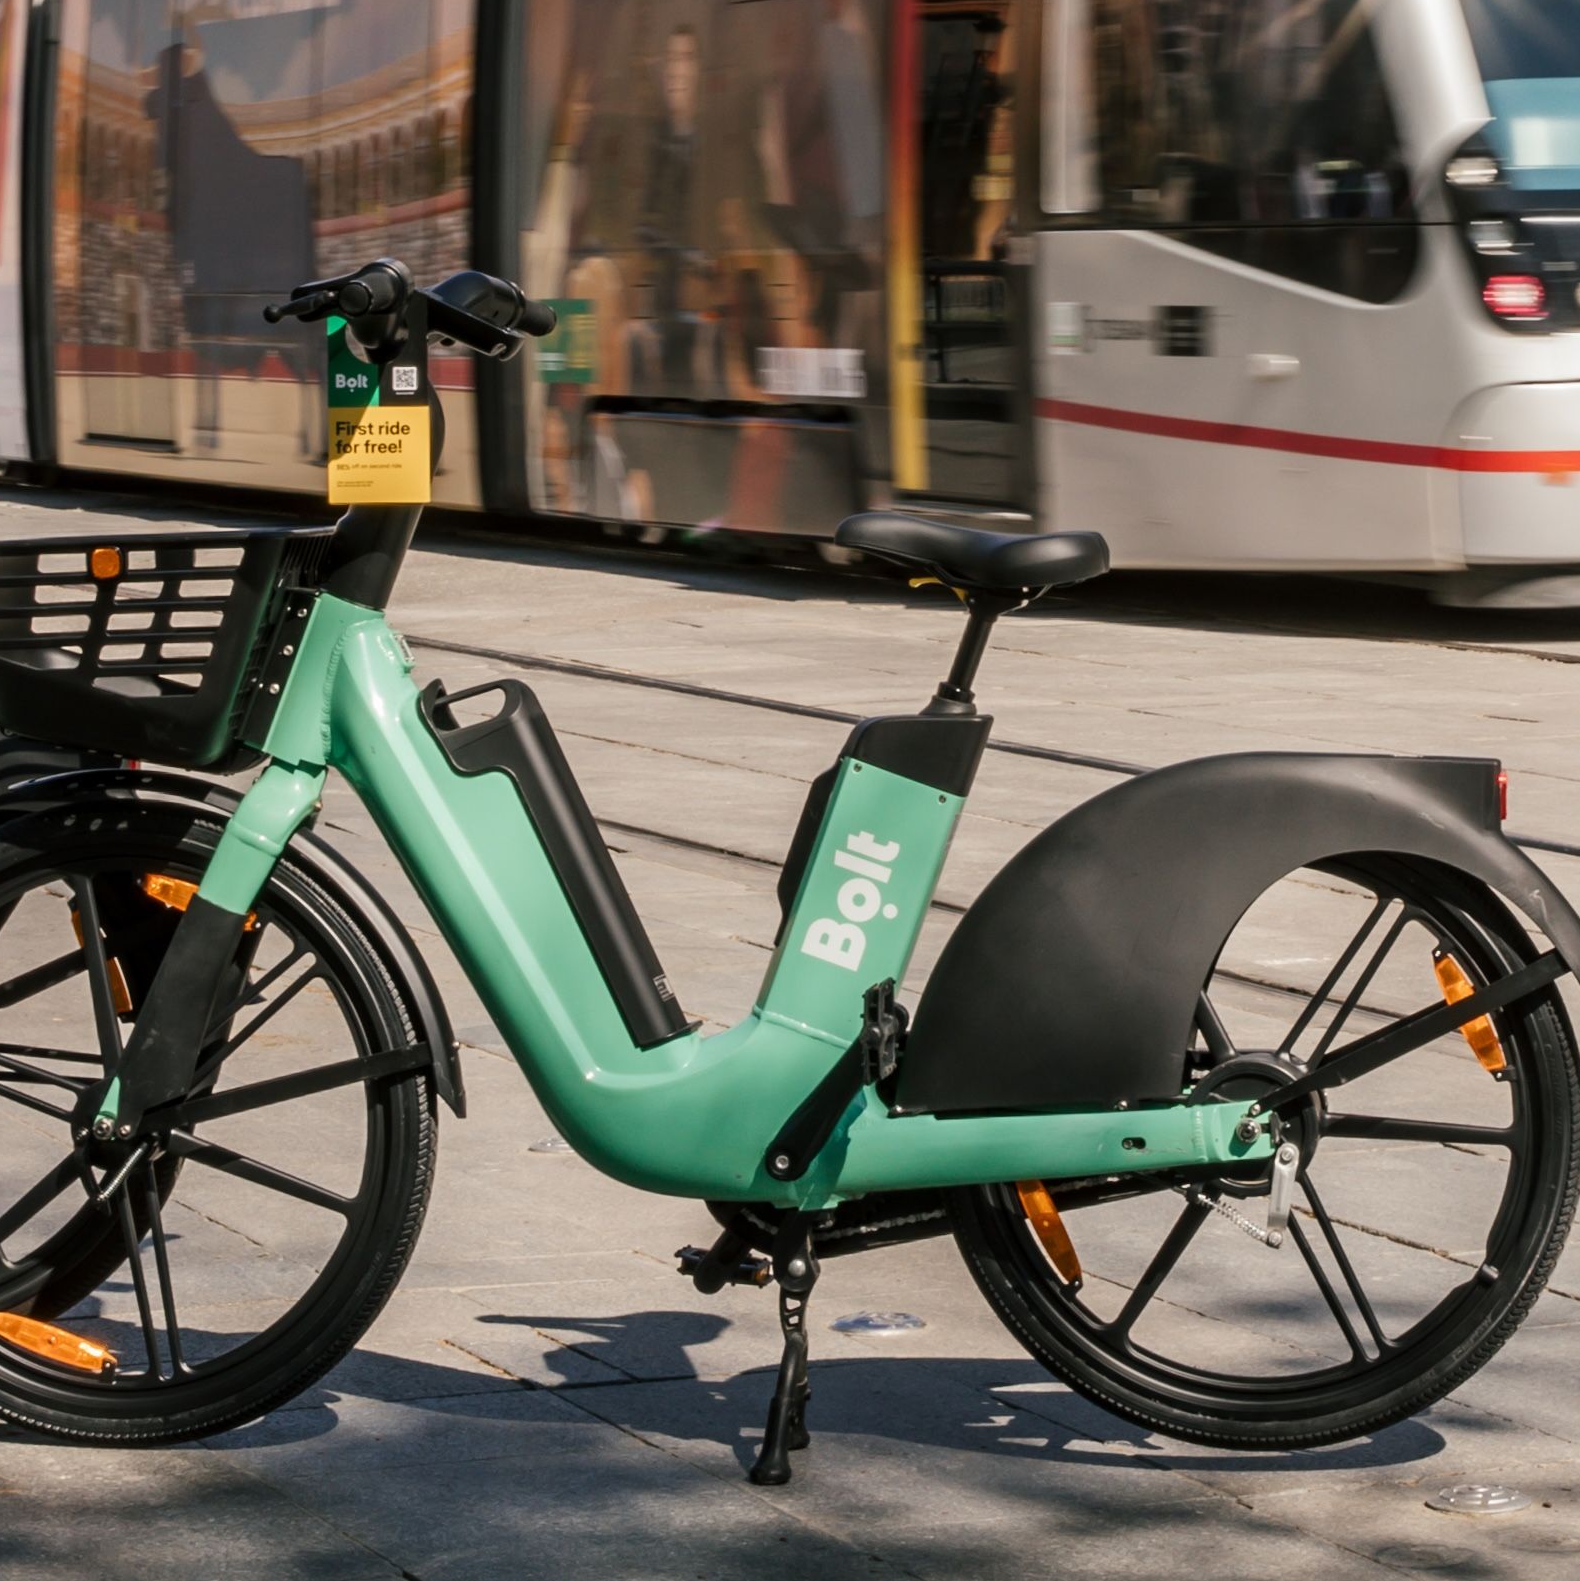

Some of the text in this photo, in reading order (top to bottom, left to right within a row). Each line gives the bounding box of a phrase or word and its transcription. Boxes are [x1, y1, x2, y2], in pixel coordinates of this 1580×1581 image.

[335, 373, 368, 393] Bolt
[335, 421, 411, 436] First ride
[335, 439, 403, 454] for free!
[800, 830, 901, 972] Bolt
